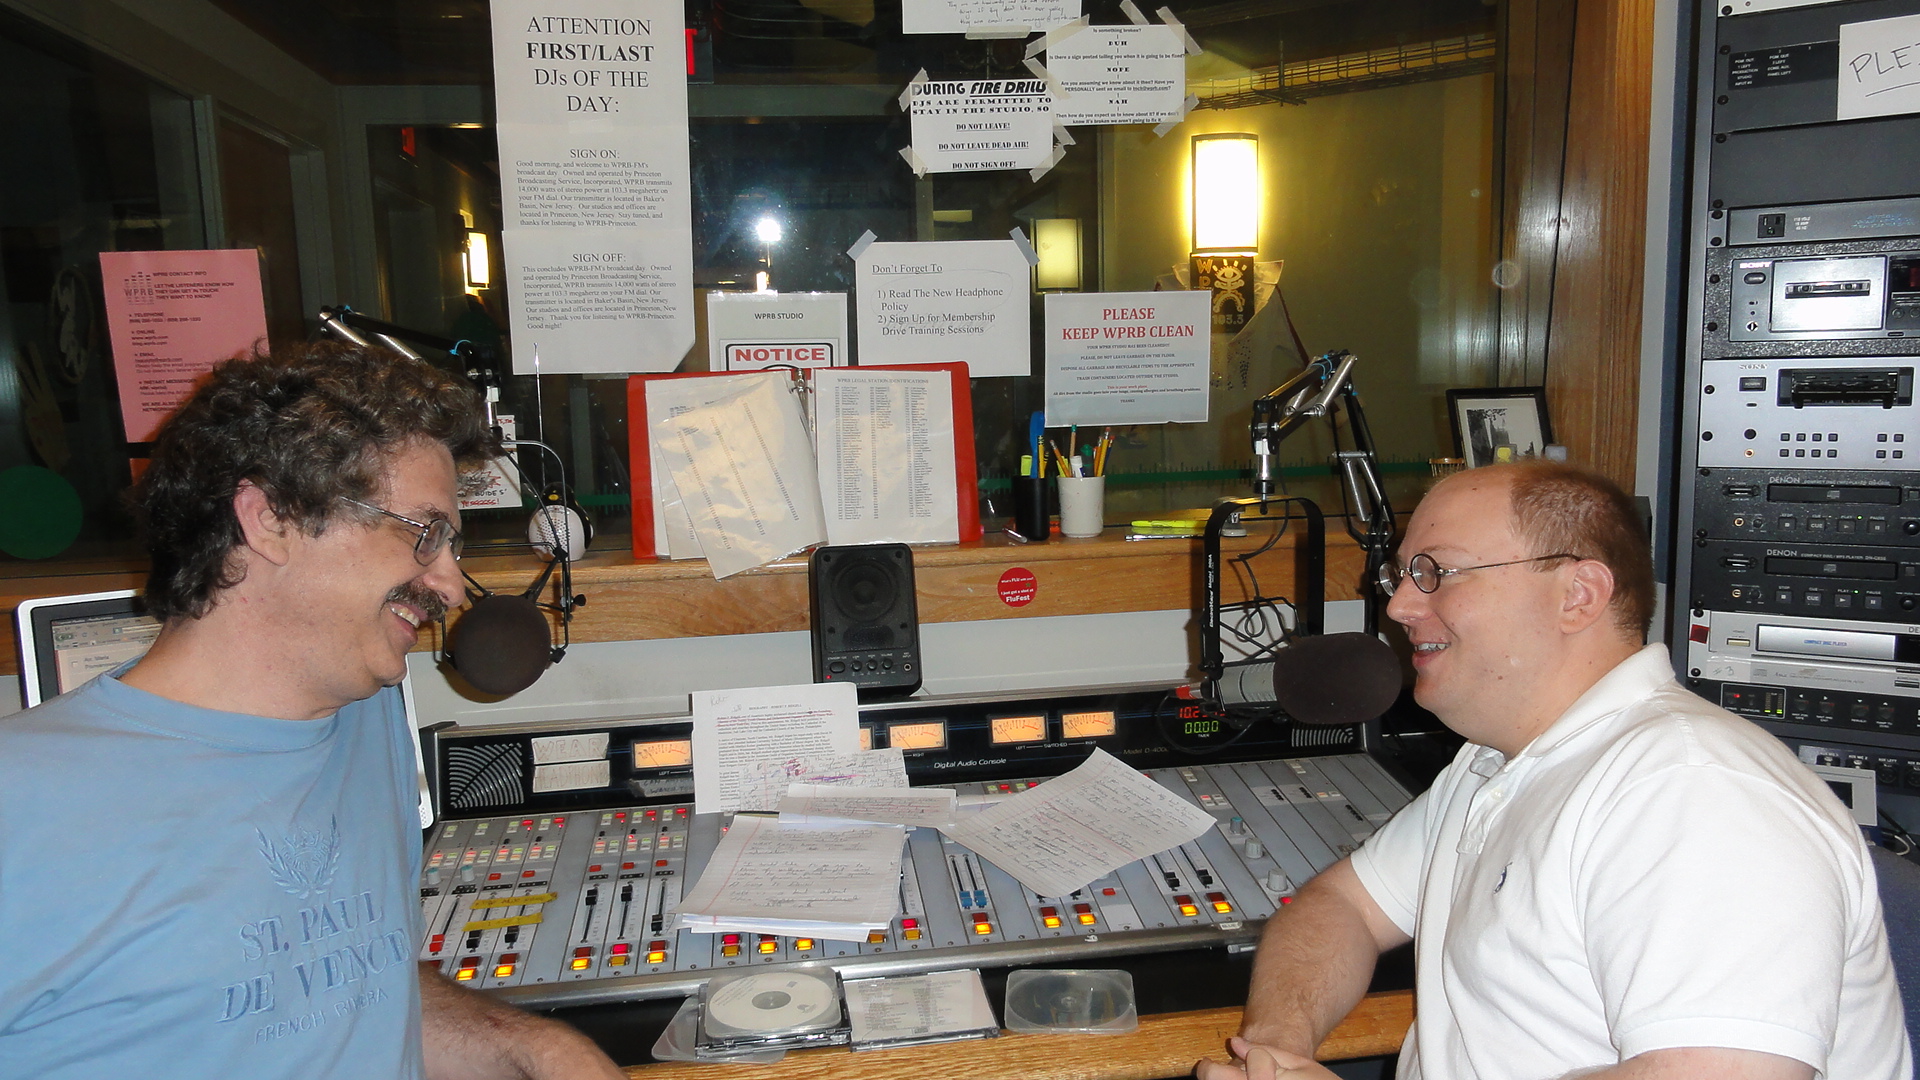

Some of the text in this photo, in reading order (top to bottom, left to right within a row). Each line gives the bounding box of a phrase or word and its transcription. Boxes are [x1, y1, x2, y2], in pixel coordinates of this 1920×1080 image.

[526, 16, 651, 36] ATTENTION
[526, 42, 654, 62] FIRST/LAST
[534, 68, 649, 88] DJs OF THE
[912, 83, 965, 95] DURING
[970, 82, 1000, 95] FIRE
[567, 95, 620, 113] DAY:
[570, 150, 620, 159] SIGN ON:
[573, 254, 626, 262] SIGN OFF:
[872, 264, 943, 274] Don't Forget To
[877, 288, 1003, 299] 1) Read The New Headphone
[881, 302, 908, 312] Policy
[877, 312, 996, 325] 2) Sign Up for Membership
[1103, 308, 1155, 320] PLEASE
[882, 325, 984, 336] Drive Training Sessions
[1062, 325, 1194, 340] KEEP WPRB CLEAN
[736, 348, 825, 361] NOTICE
[534, 738, 604, 761] WEAR
[934, 760, 956, 769] Digital
[239, 889, 384, 962] ST. PAUL
[216, 928, 412, 1024] DE VENCE
[255, 1009, 326, 1045] FRENCH
